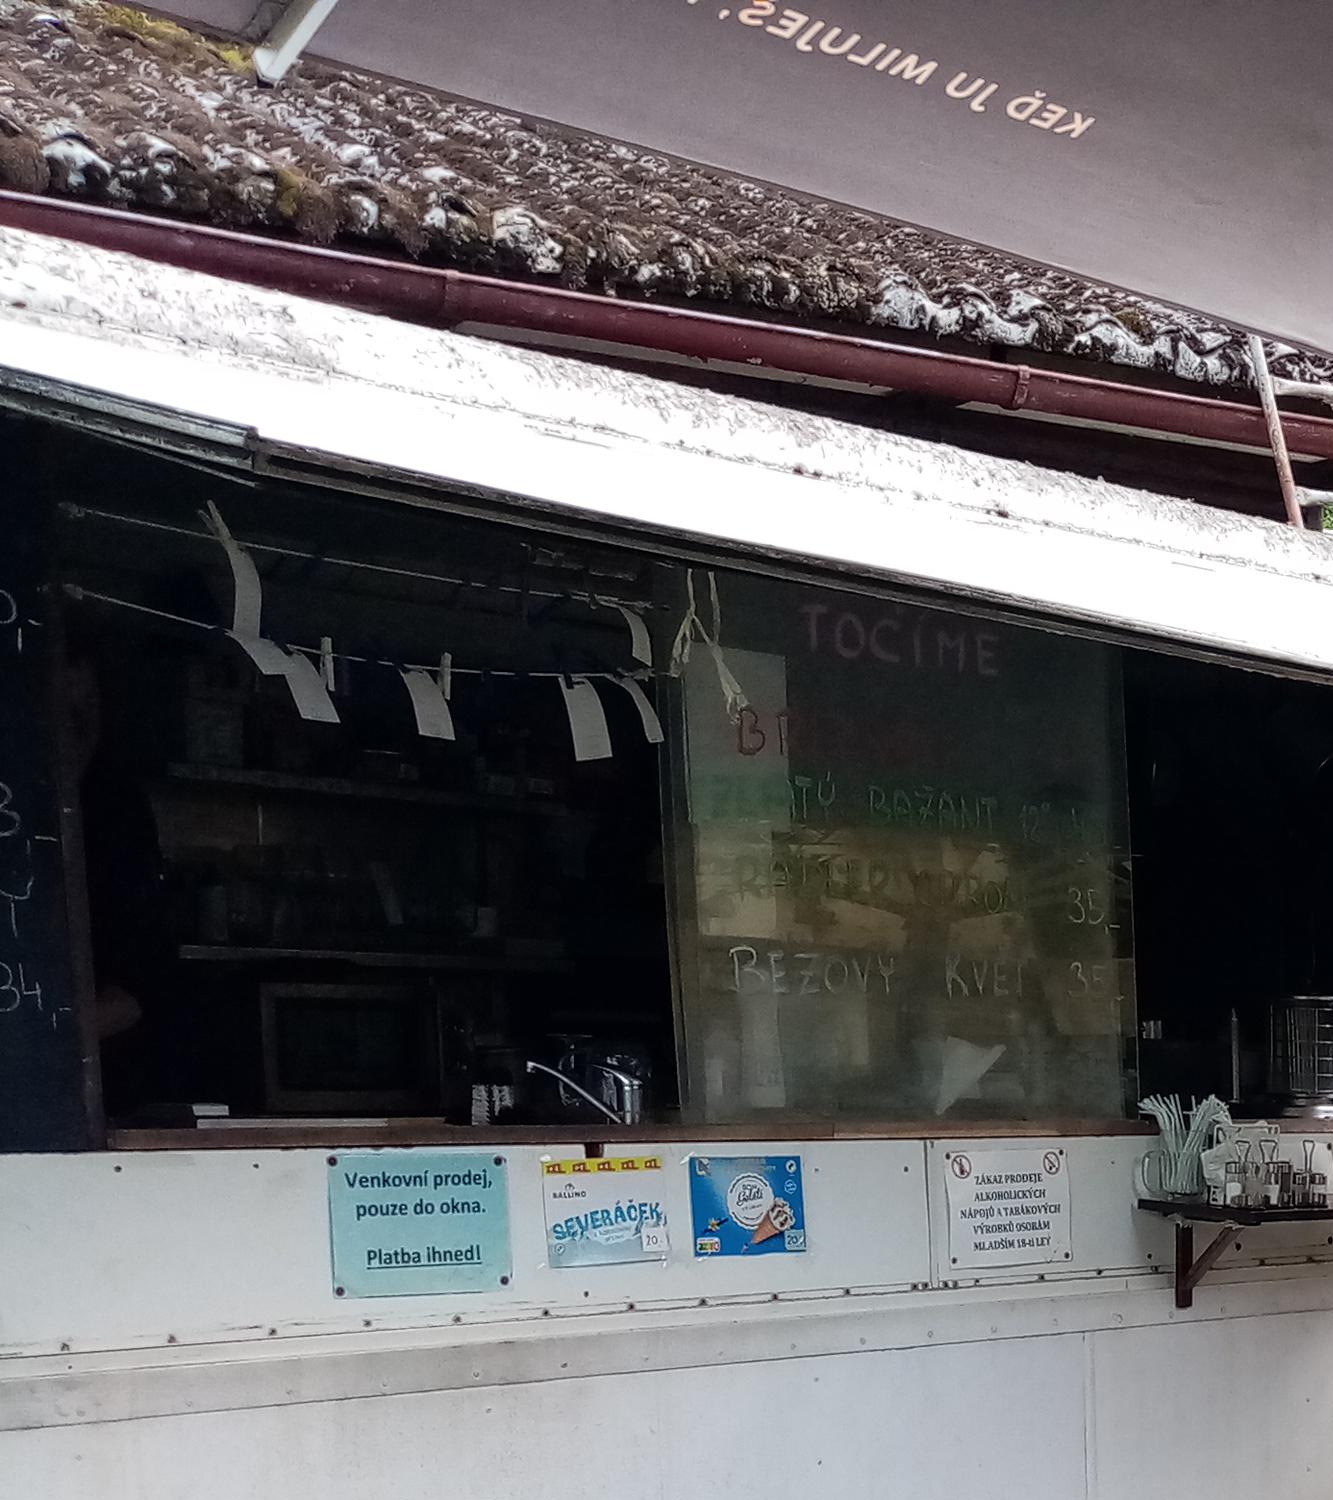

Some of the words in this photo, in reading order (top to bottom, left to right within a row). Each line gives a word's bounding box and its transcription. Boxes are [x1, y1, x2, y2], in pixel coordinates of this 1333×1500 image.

[802, 600, 1001, 677] TOČÍME
[344, 1169, 428, 1189] Venkovní
[433, 1169, 493, 1190] prodej,
[974, 1173, 1003, 1185] ZÁKAZ
[1005, 1173, 1043, 1183] PRODEJE
[974, 1187, 1046, 1202] ALKOHOLICKÝCH
[356, 1202, 408, 1221] pouze
[413, 1198, 435, 1215] do
[440, 1197, 487, 1215] okna.
[960, 1206, 995, 1219] NÁPOJŮ
[997, 1209, 1003, 1217] A
[1004, 1203, 1061, 1216] TABÁKOVÝCH
[552, 1199, 663, 1241] SEVERÁČEK
[973, 1221, 1014, 1235] VÝROBKŮ
[1016, 1220, 1050, 1232] OSOBÁM
[973, 1237, 1016, 1251] MLADŠÍM
[366, 1248, 422, 1268] Platba
[427, 1244, 482, 1265] ihned!
